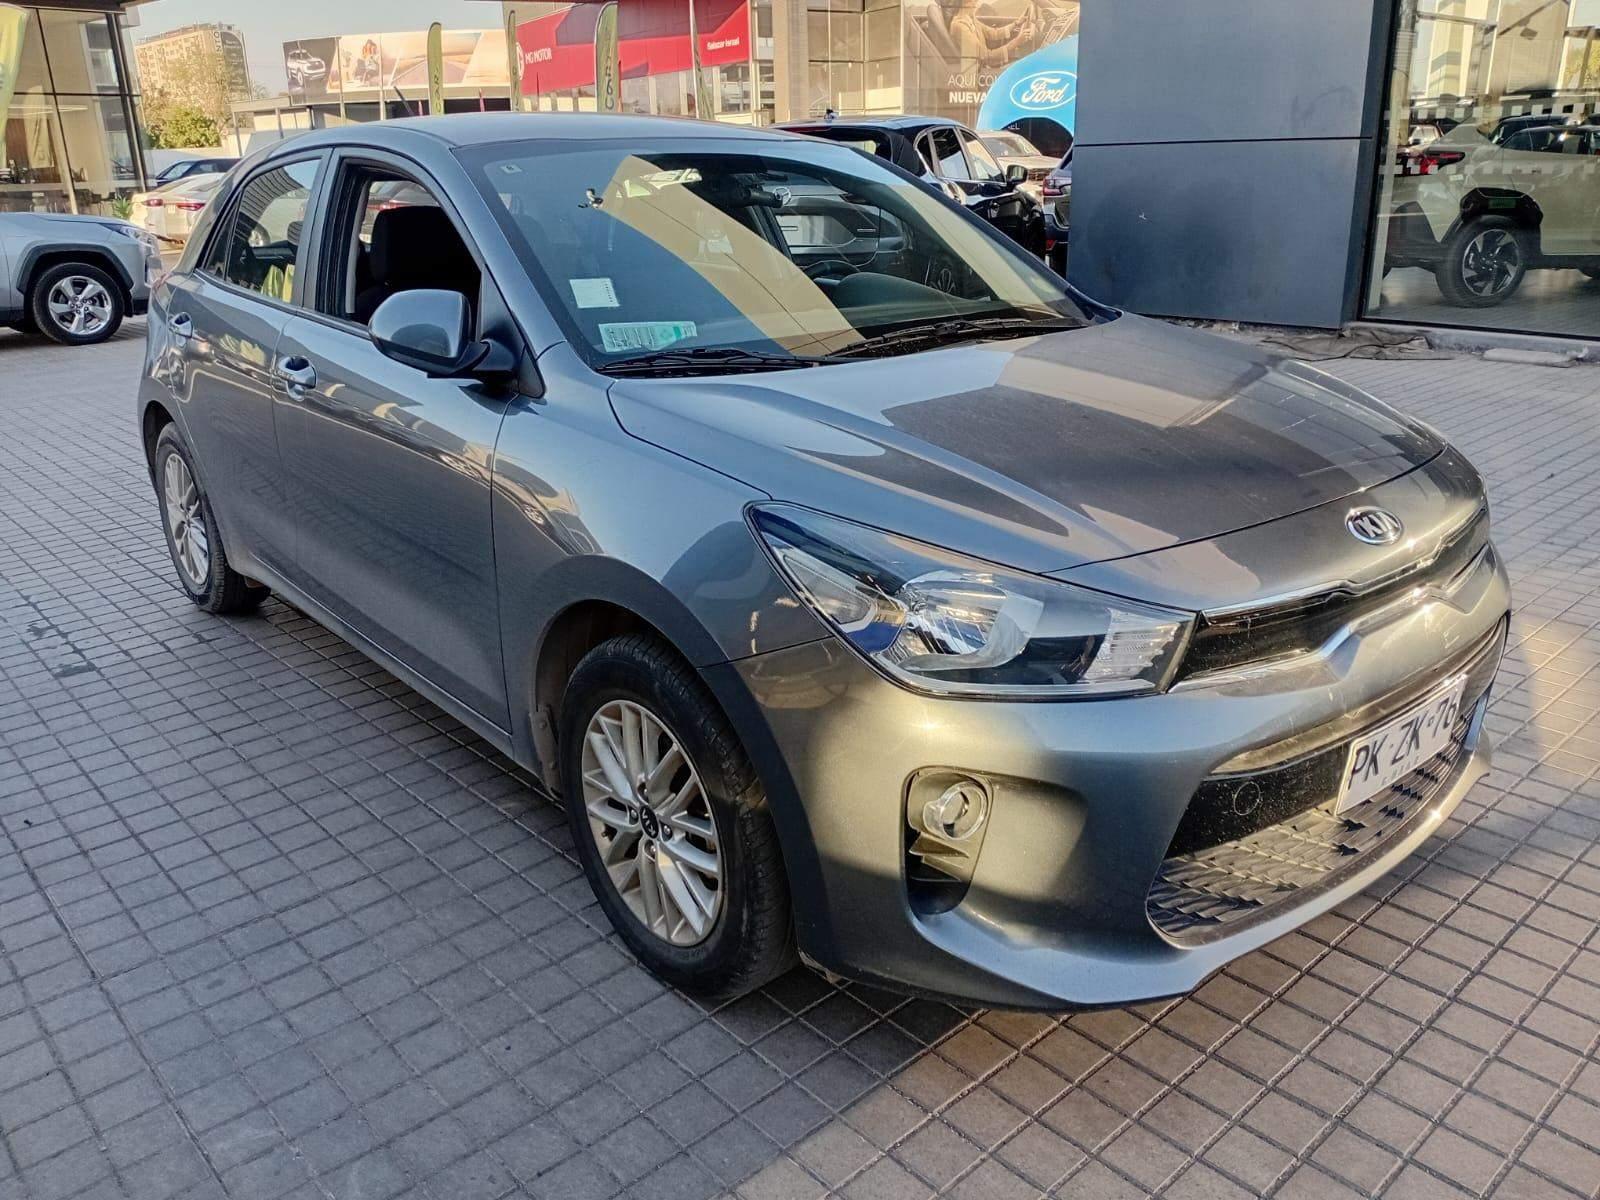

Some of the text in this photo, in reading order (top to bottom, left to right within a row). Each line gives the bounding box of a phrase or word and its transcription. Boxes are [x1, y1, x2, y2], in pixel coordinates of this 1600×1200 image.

[534, 47, 552, 63] MOTOR
[1022, 77, 1069, 103] Ford
[1354, 510, 1400, 539] KIA
